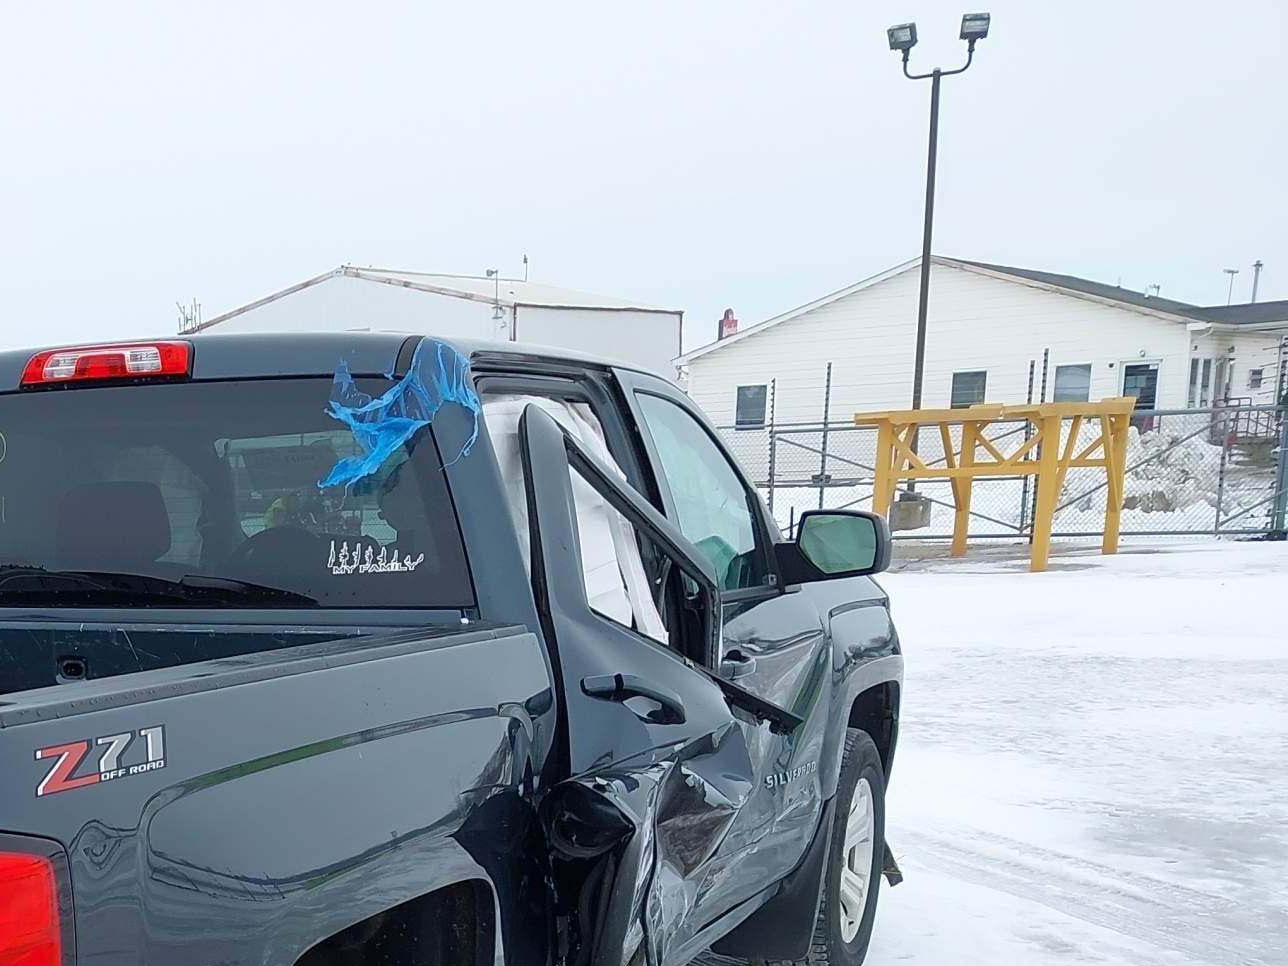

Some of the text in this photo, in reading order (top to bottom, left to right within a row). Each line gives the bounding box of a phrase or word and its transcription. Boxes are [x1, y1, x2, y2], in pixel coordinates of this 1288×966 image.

[332, 555, 424, 575] MY FAMILY
[33, 724, 168, 798] Z71
[100, 760, 166, 782] OFF ROAD
[766, 760, 816, 789] SILVERADO
